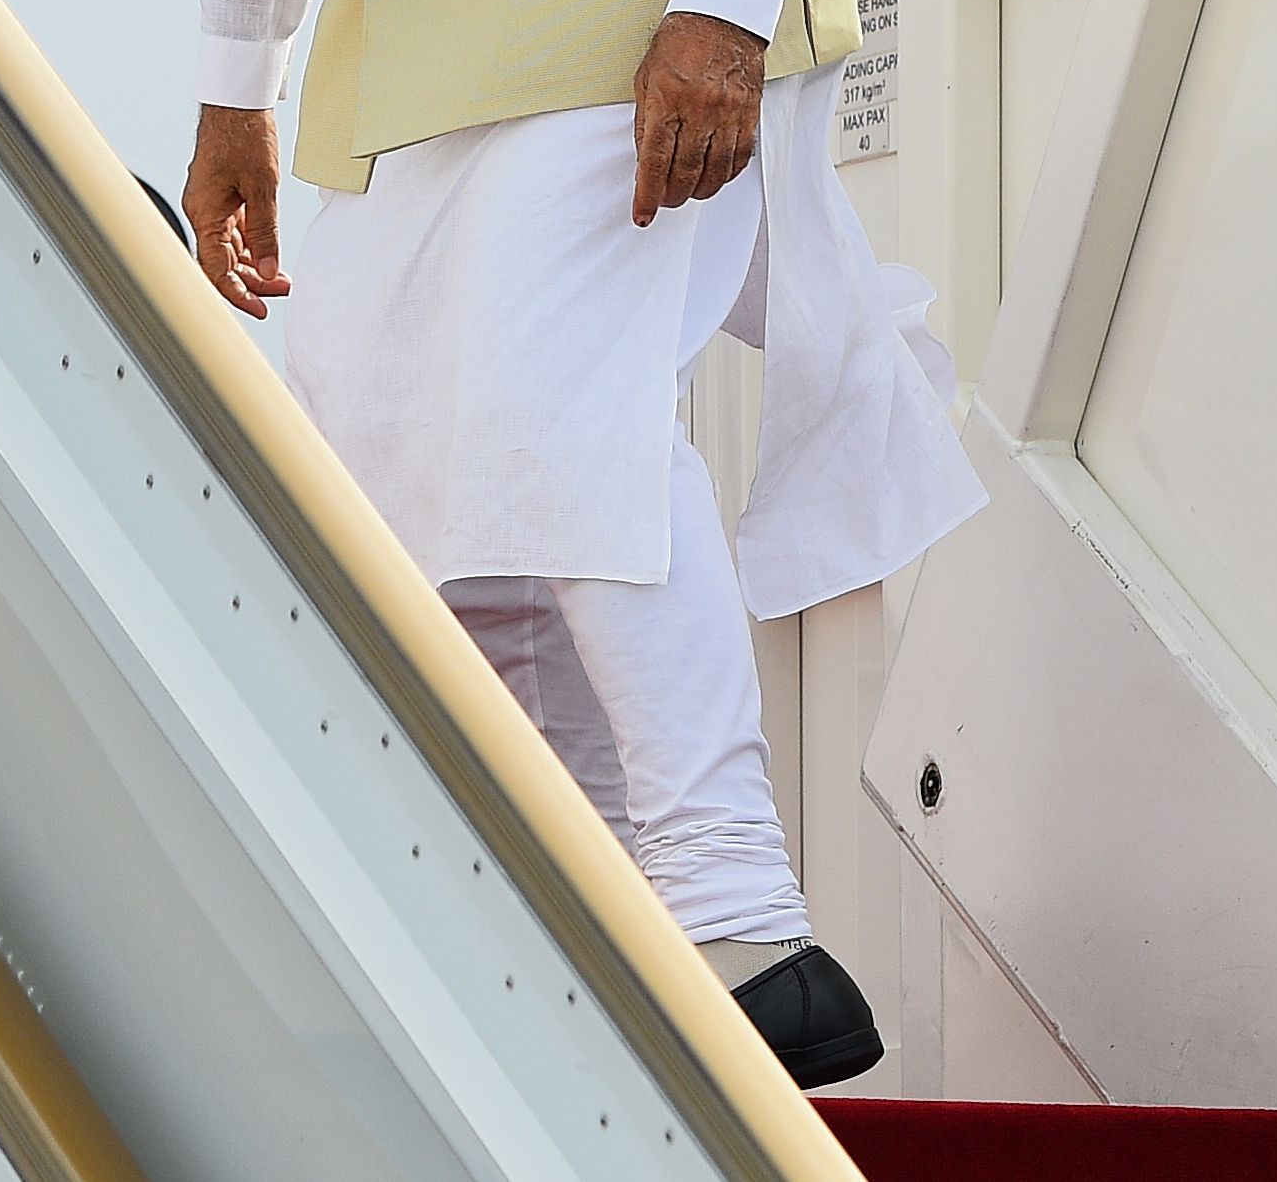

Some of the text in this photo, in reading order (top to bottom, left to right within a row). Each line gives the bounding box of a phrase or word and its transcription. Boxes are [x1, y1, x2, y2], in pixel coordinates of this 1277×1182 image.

[878, 13, 891, 30] ON
[844, 85, 860, 104] 317
[843, 106, 885, 132] MAX PAX
[859, 134, 870, 151] 40
